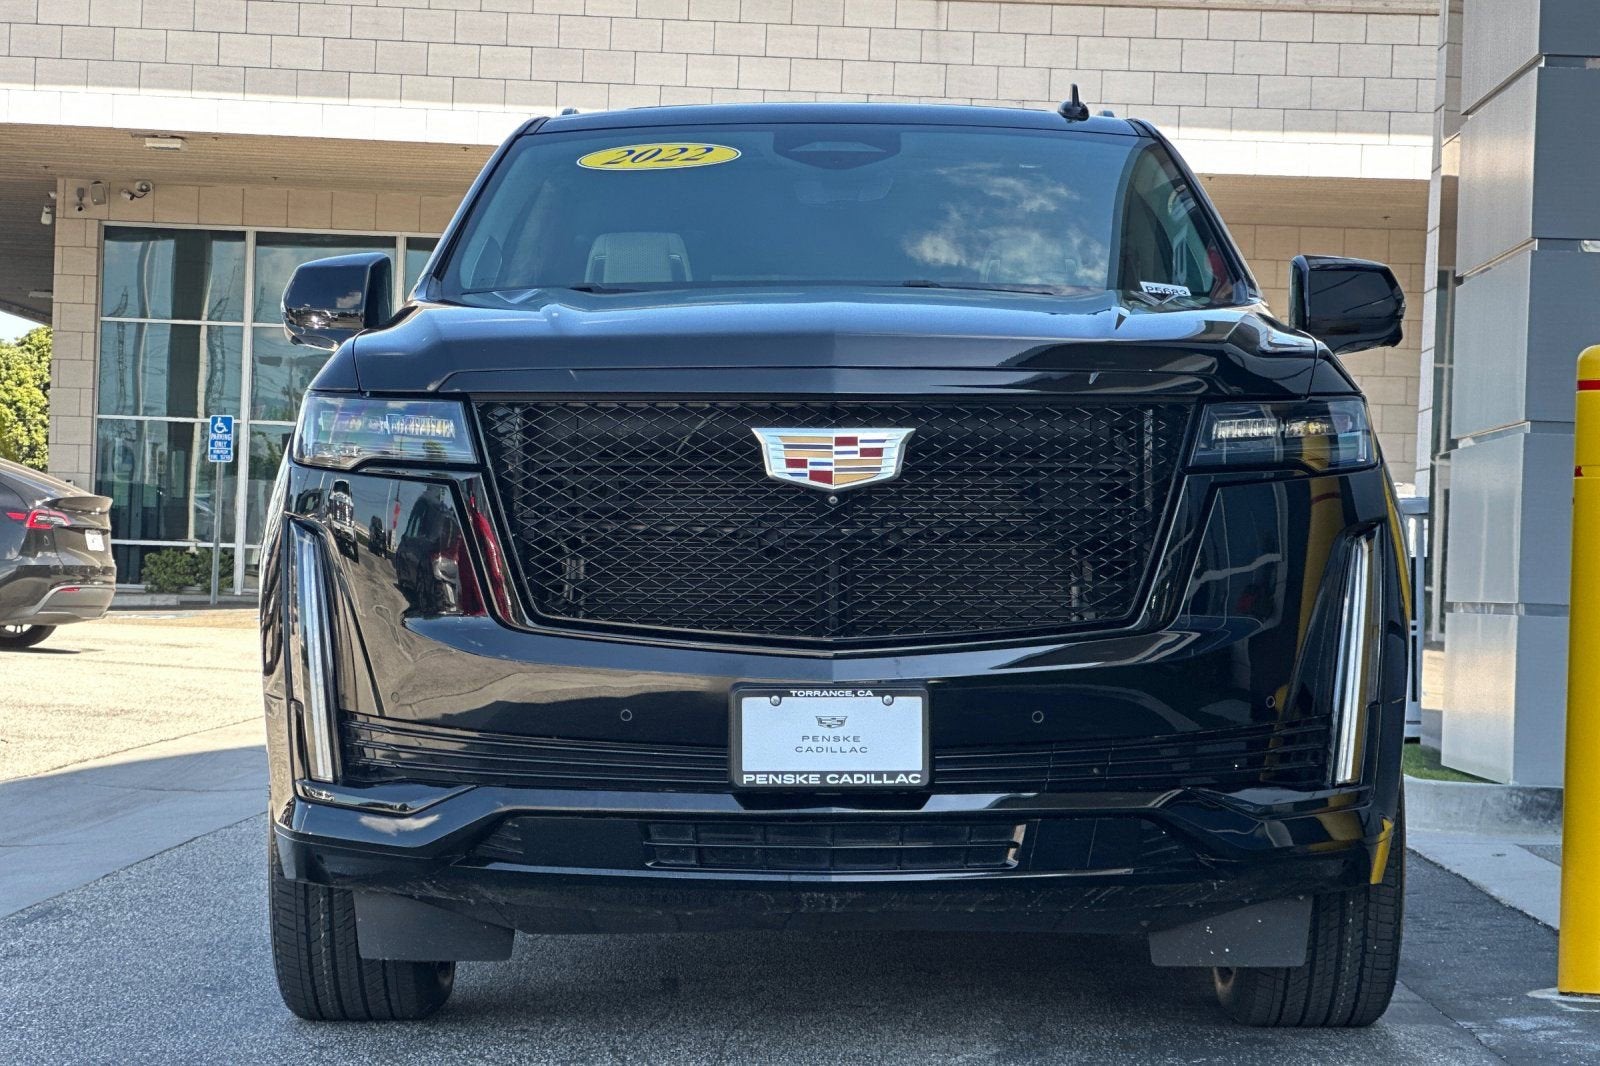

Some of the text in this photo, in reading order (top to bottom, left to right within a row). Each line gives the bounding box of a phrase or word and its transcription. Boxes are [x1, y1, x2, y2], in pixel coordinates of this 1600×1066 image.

[600, 146, 714, 165] 2022
[790, 690, 855, 698] TORRANCE,
[795, 746, 868, 754] CADILLAC
[742, 773, 921, 785] PENSKE CADILLAC
